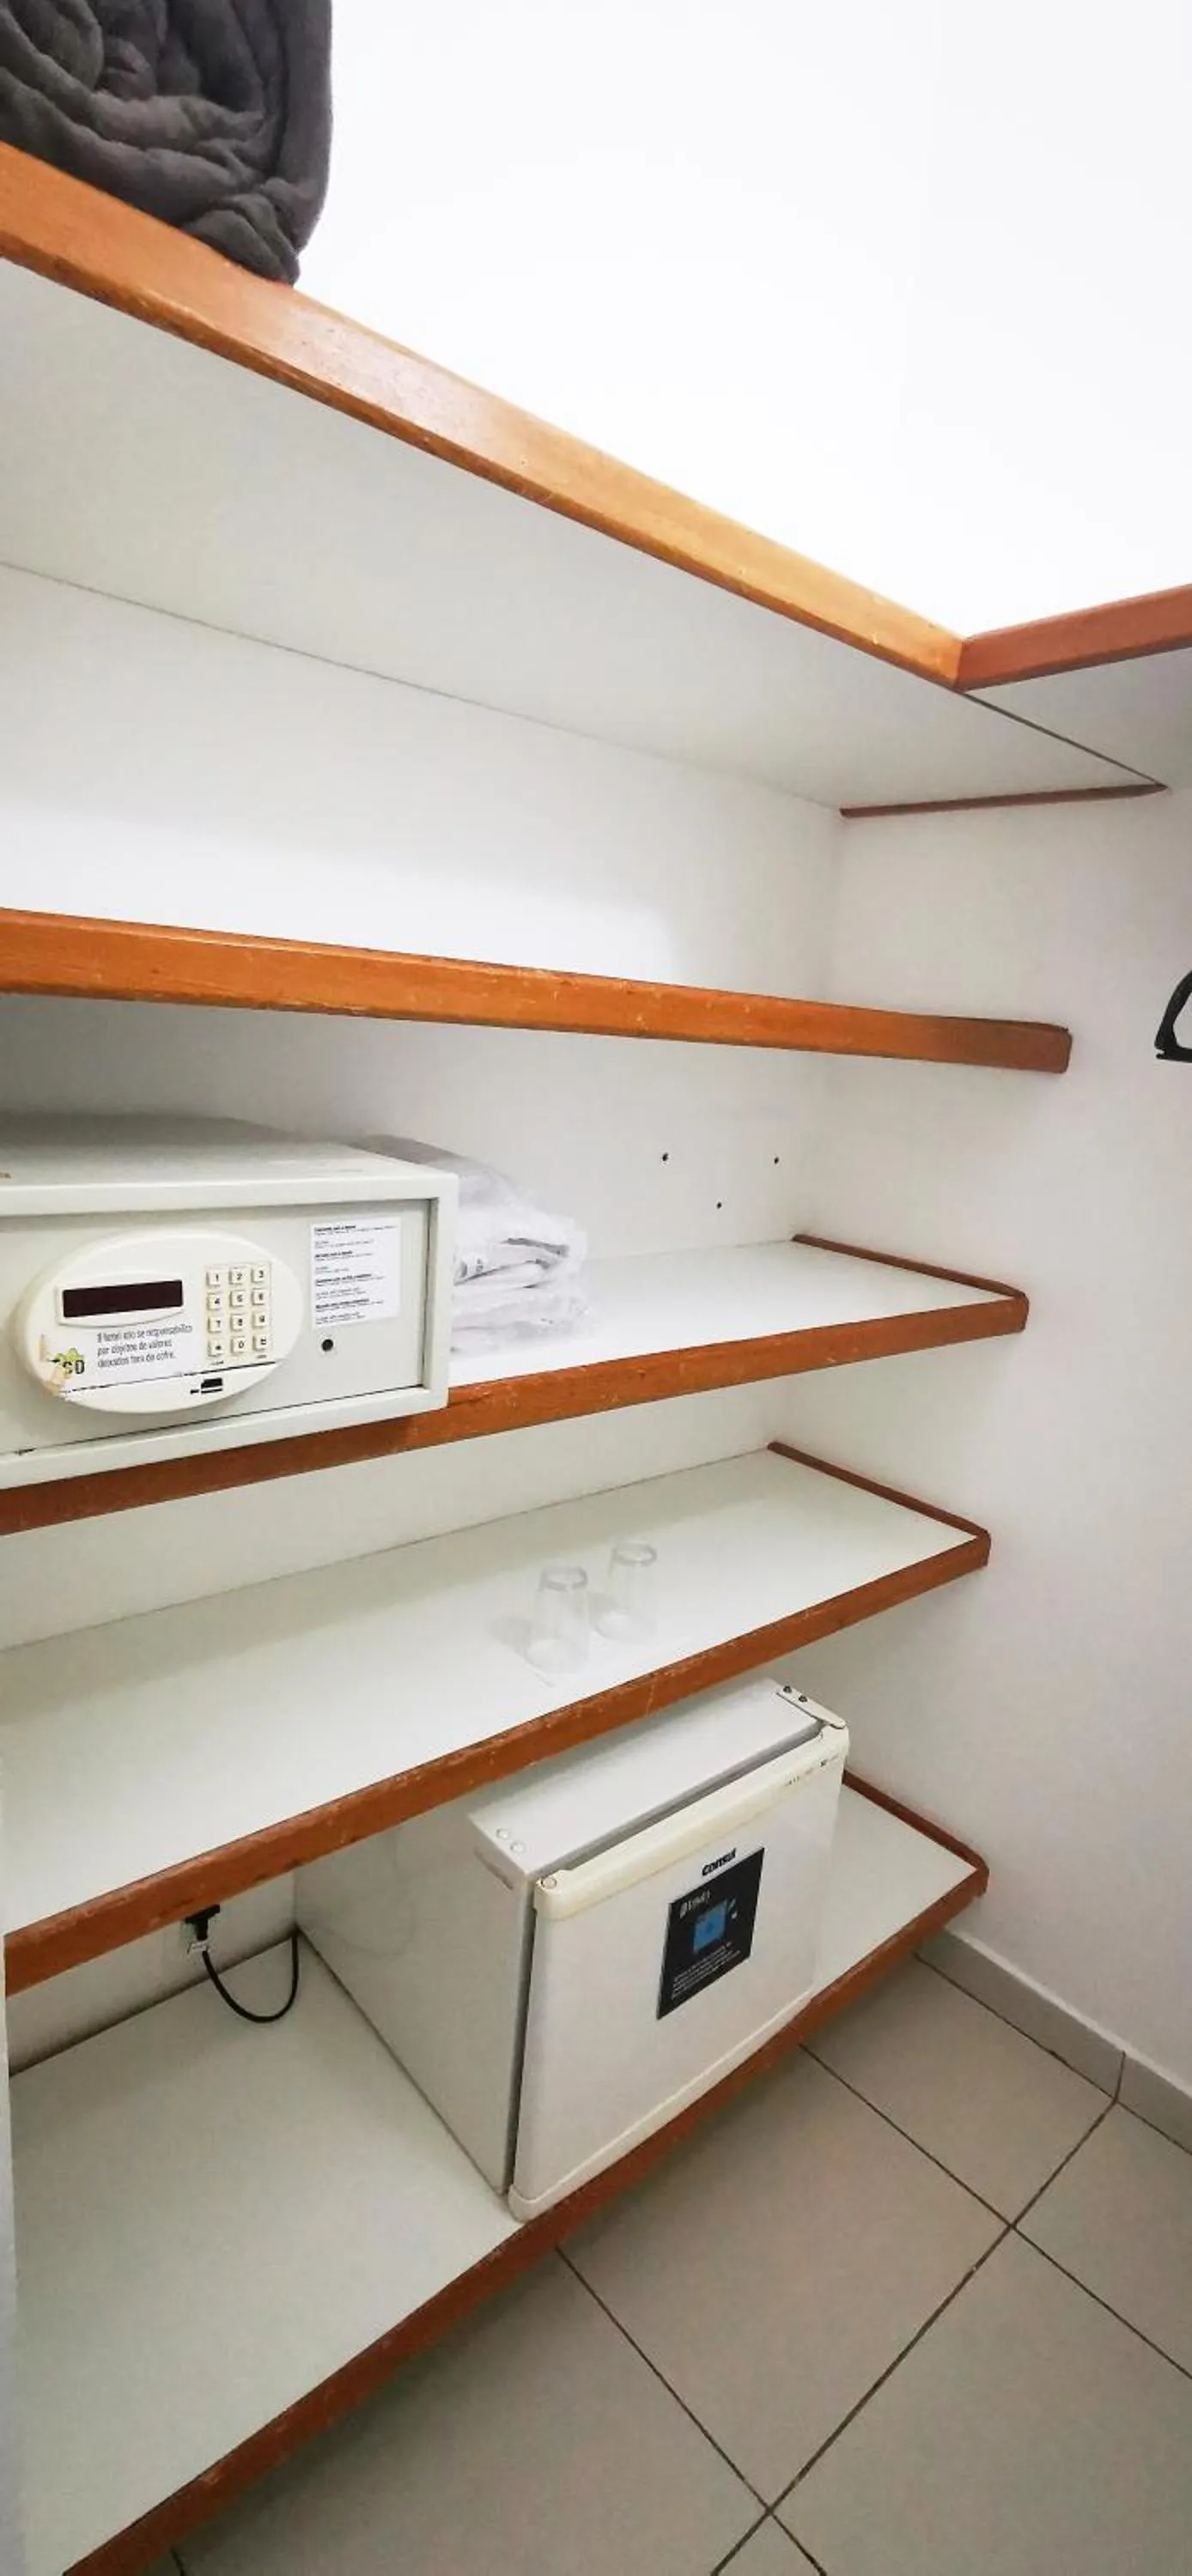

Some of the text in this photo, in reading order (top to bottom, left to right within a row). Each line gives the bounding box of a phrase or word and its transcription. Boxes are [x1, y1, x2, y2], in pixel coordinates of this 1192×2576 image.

[137, 1329, 145, 1339] se
[97, 1346, 110, 1357] por
[139, 1340, 149, 1351] de
